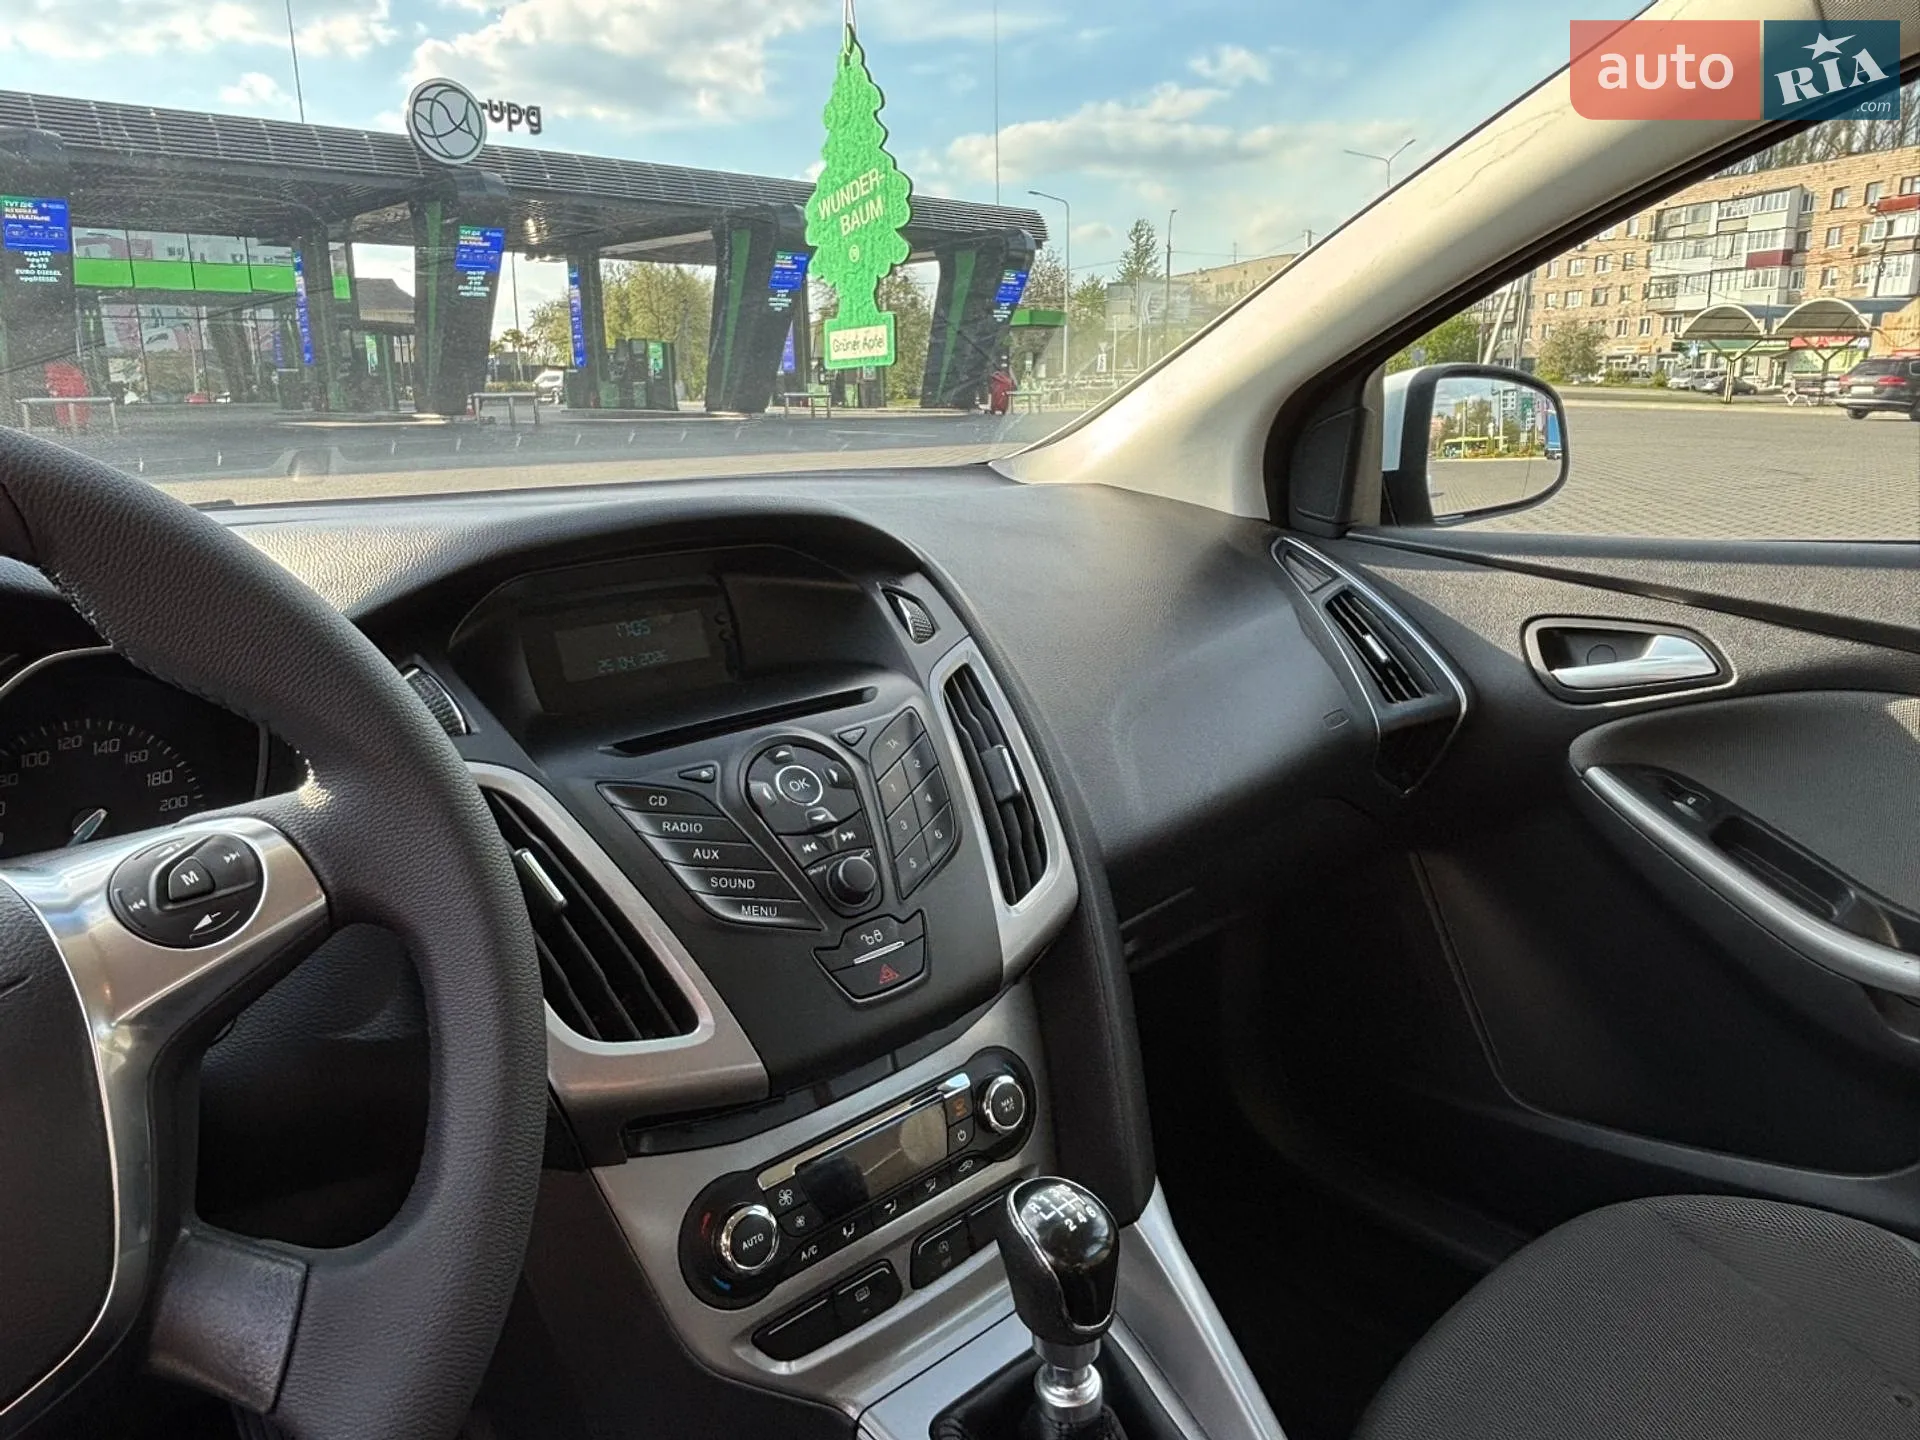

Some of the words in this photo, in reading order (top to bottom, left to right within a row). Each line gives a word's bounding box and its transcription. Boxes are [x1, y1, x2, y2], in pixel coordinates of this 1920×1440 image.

[487, 100, 543, 135] upg
[817, 167, 886, 220] WUNDER-
[839, 195, 885, 237] BAUM
[57, 735, 83, 751] 120
[93, 738, 121, 755] 140
[21, 751, 50, 769] 100
[124, 749, 149, 765] 160
[913, 759, 921, 769] 2
[146, 769, 174, 787] 180
[789, 777, 811, 793] OK
[160, 795, 189, 812] 200
[649, 795, 668, 806] CD
[662, 821, 703, 833] RADIO
[900, 820, 908, 831] 3
[934, 828, 943, 839] 6
[692, 848, 719, 860] AUX
[908, 857, 917, 869] 5
[180, 870, 200, 886] M
[710, 876, 756, 890] SOUND
[741, 904, 778, 917] MENU
[1028, 1202, 1042, 1214] R
[1085, 1206, 1097, 1218] 6
[1076, 1211, 1087, 1223] 4
[1064, 1218, 1077, 1232] 2
[742, 1233, 764, 1251] AUTO
[801, 1244, 818, 1261] A/C
